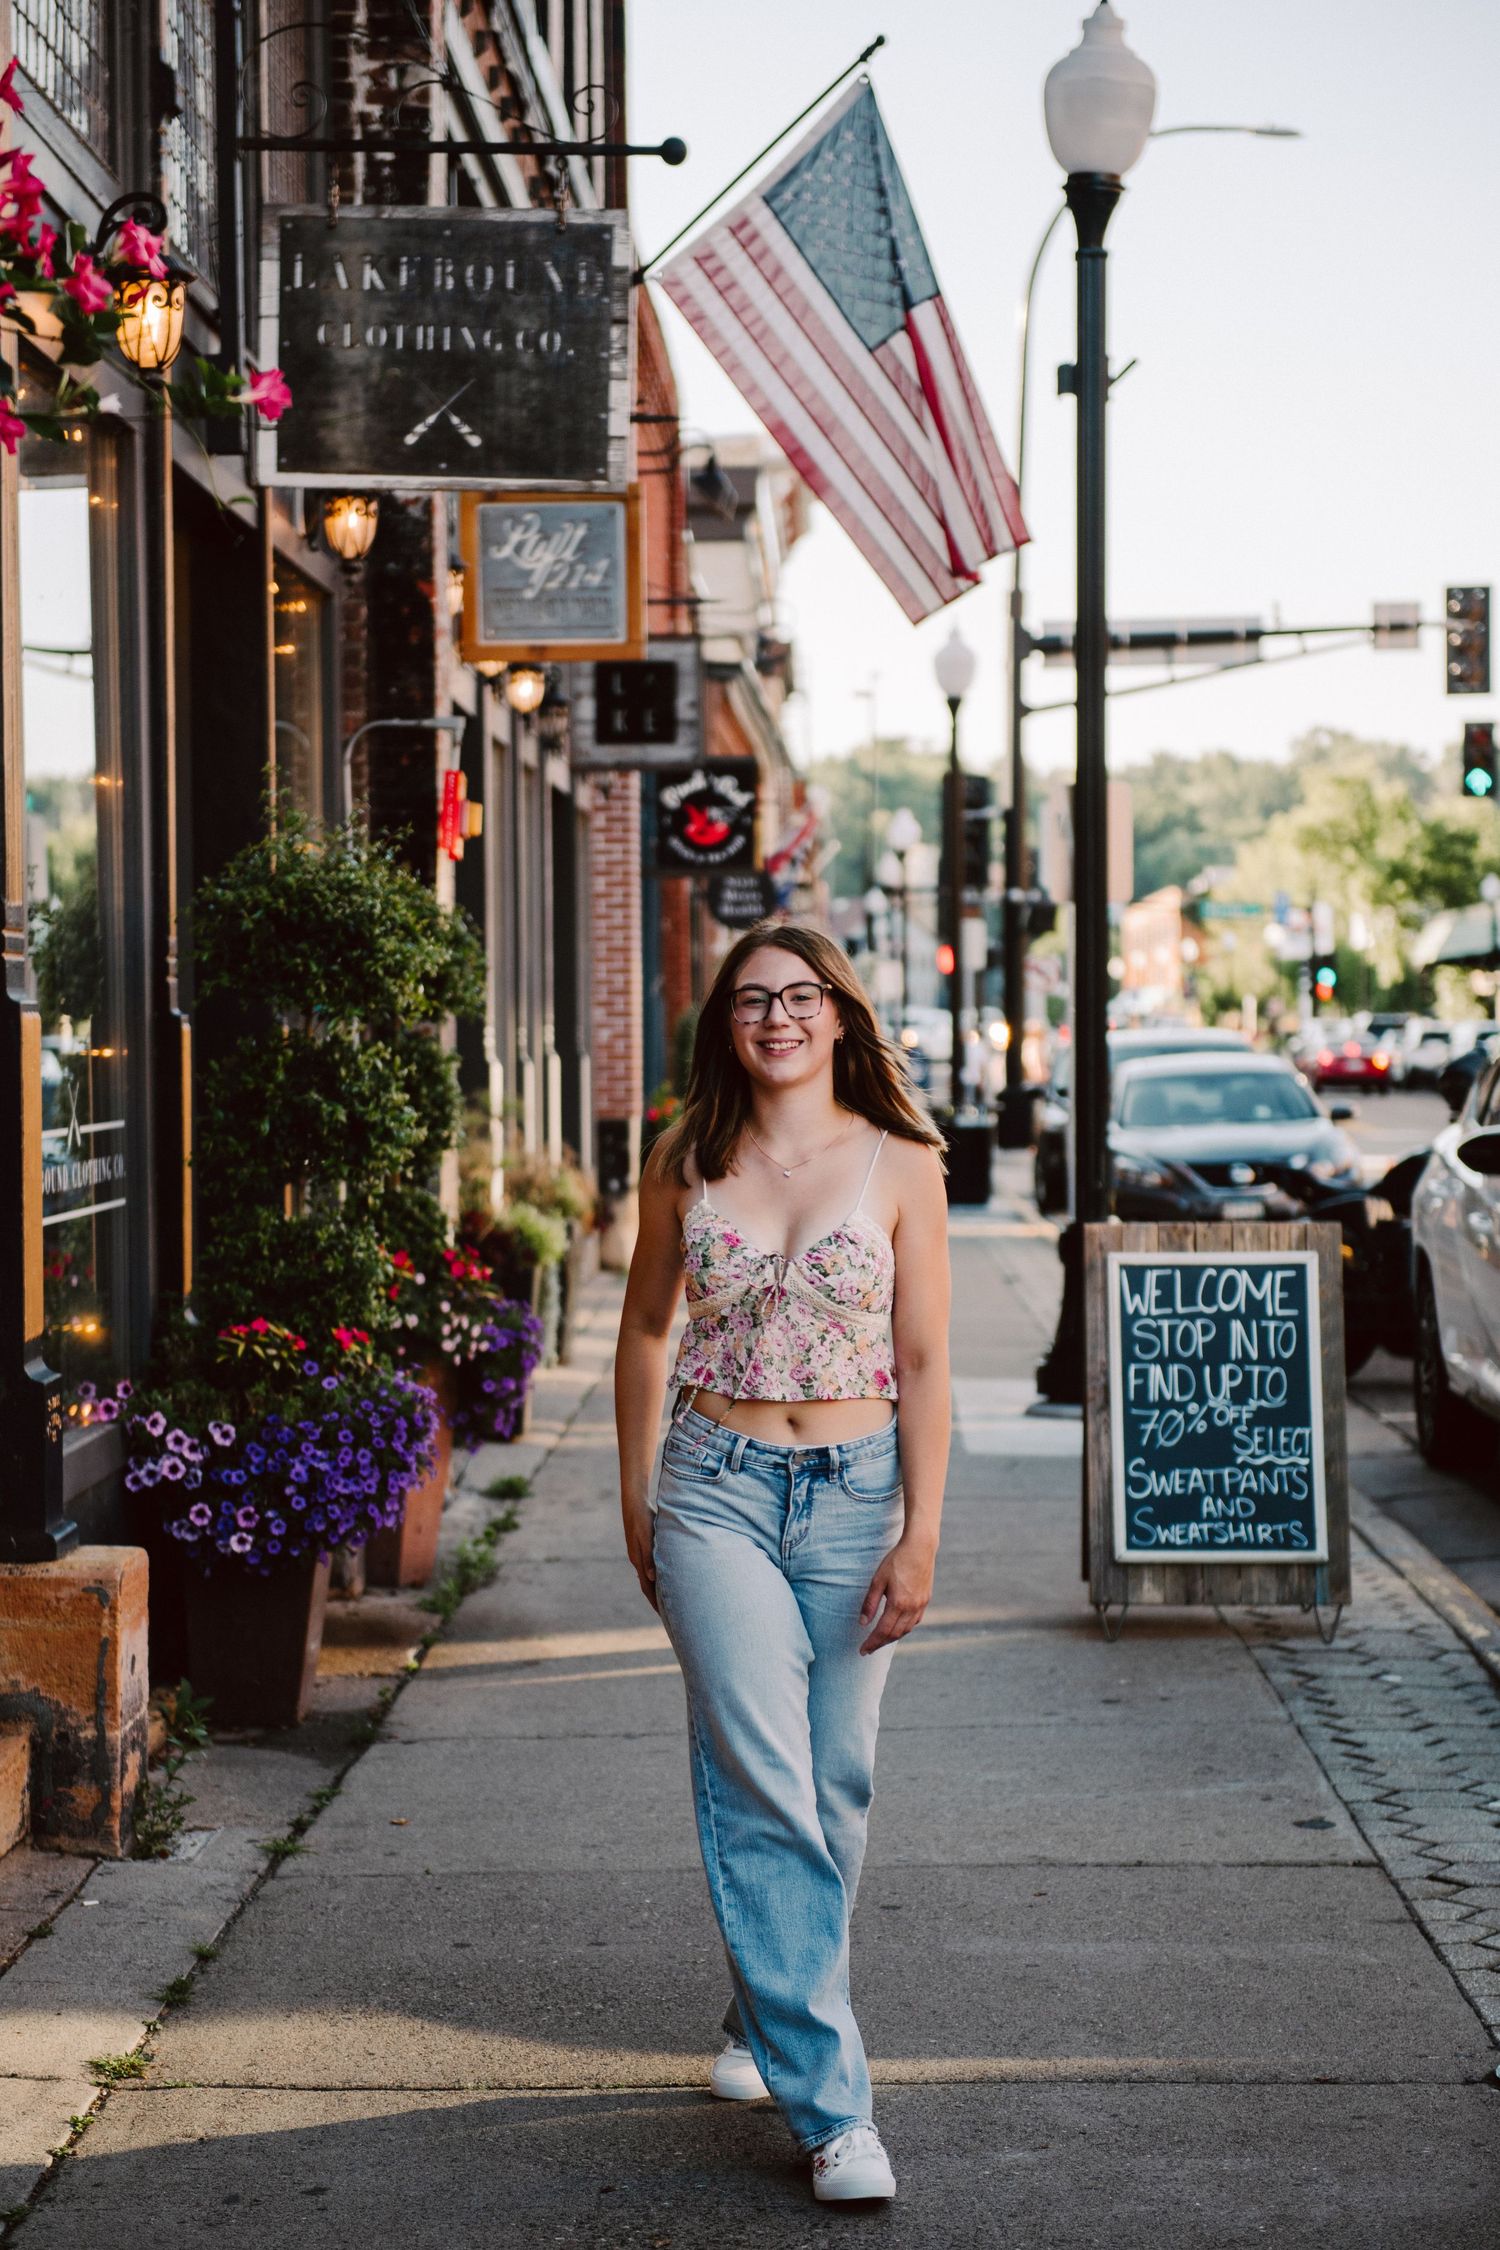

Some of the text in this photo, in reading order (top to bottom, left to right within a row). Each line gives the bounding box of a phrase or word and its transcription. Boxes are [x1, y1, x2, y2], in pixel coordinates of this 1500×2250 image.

[316, 321, 575, 356] CLOTHING CO.
[42, 1164, 69, 1195] OUND
[72, 1156, 112, 1189] CLOTHING
[1121, 1267, 1299, 1317] WELCOME
[1132, 1318, 1217, 1360] STOP
[1128, 1363, 1288, 1403] FIND UP TO
[1130, 1402, 1256, 1449] 70% OFF
[1232, 1425, 1312, 1457] SELECT
[1202, 1495, 1257, 1519] AND
